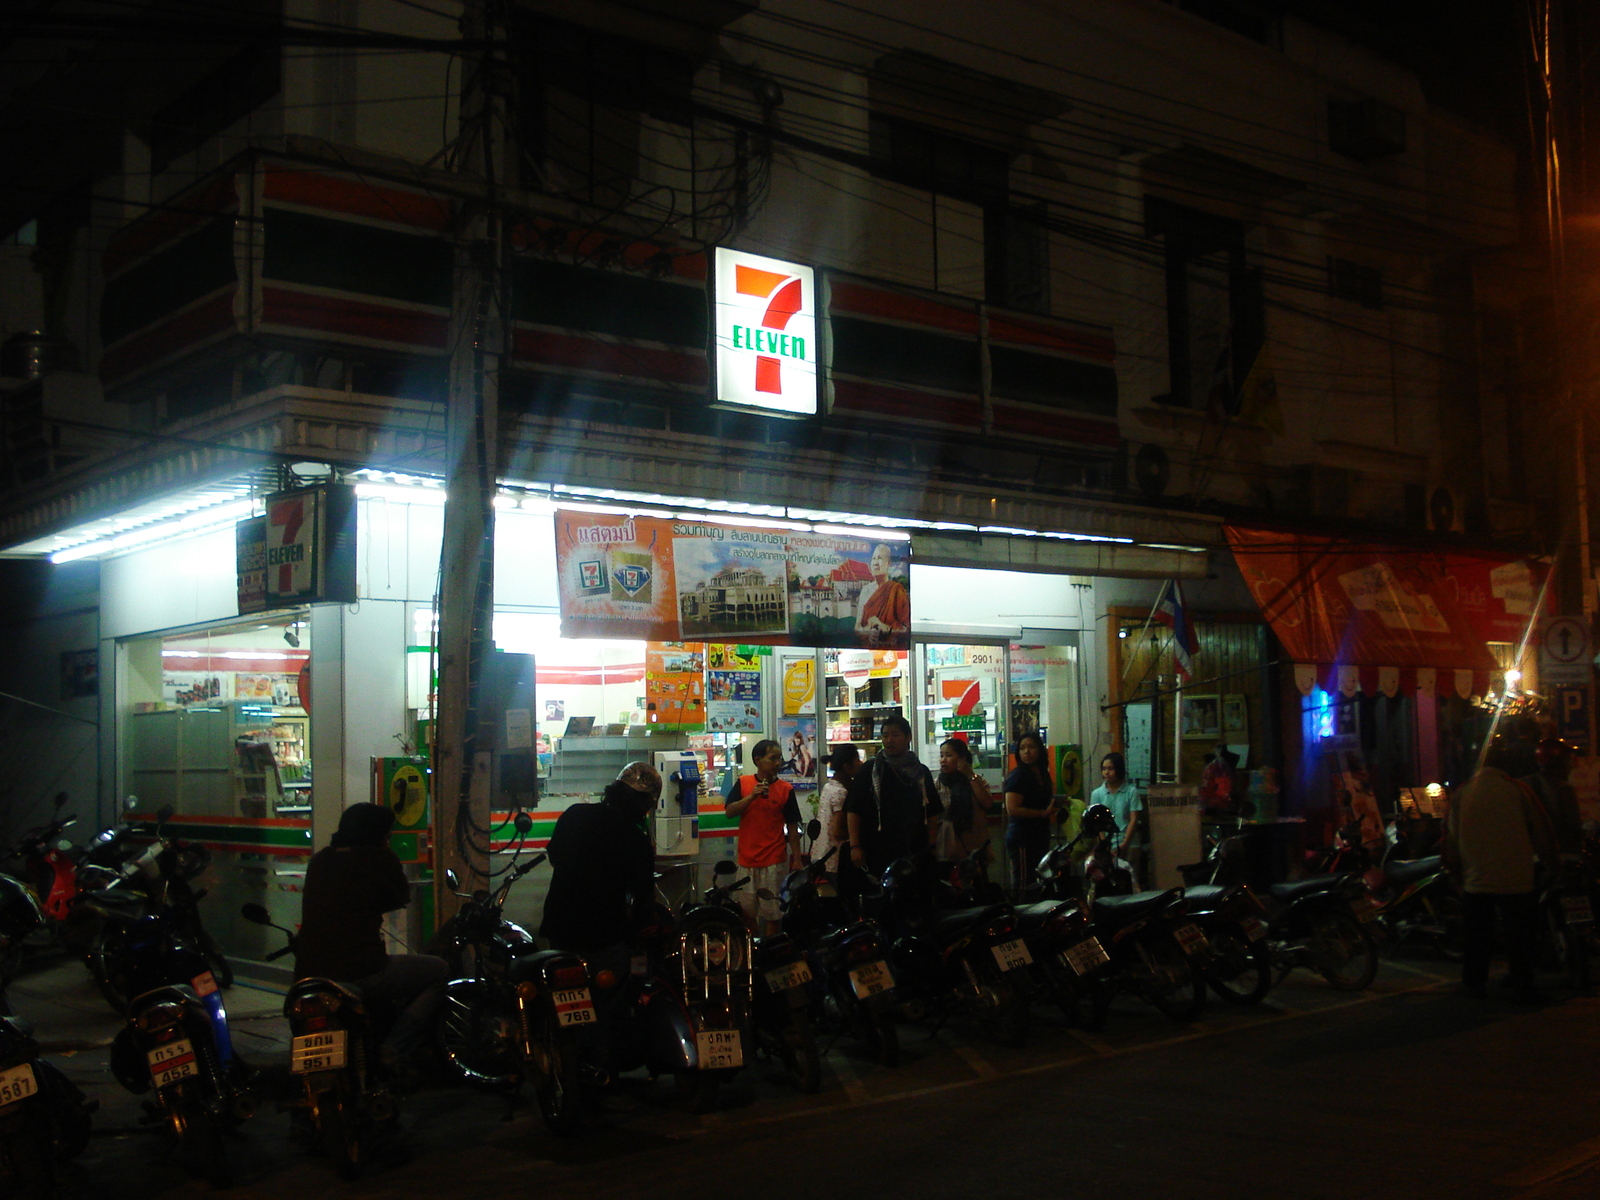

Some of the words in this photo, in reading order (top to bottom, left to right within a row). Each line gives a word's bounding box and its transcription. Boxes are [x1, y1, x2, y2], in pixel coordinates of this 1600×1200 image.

[735, 263, 803, 395] 7
[578, 519, 636, 543] แสตมป์
[270, 498, 304, 593] 7
[972, 654, 993, 665] 2901
[1562, 690, 1583, 723] P
[563, 1009, 591, 1023] 769
[162, 1064, 191, 1084] 452
[302, 1055, 331, 1069] 951
[0, 1077, 31, 1103] 587
